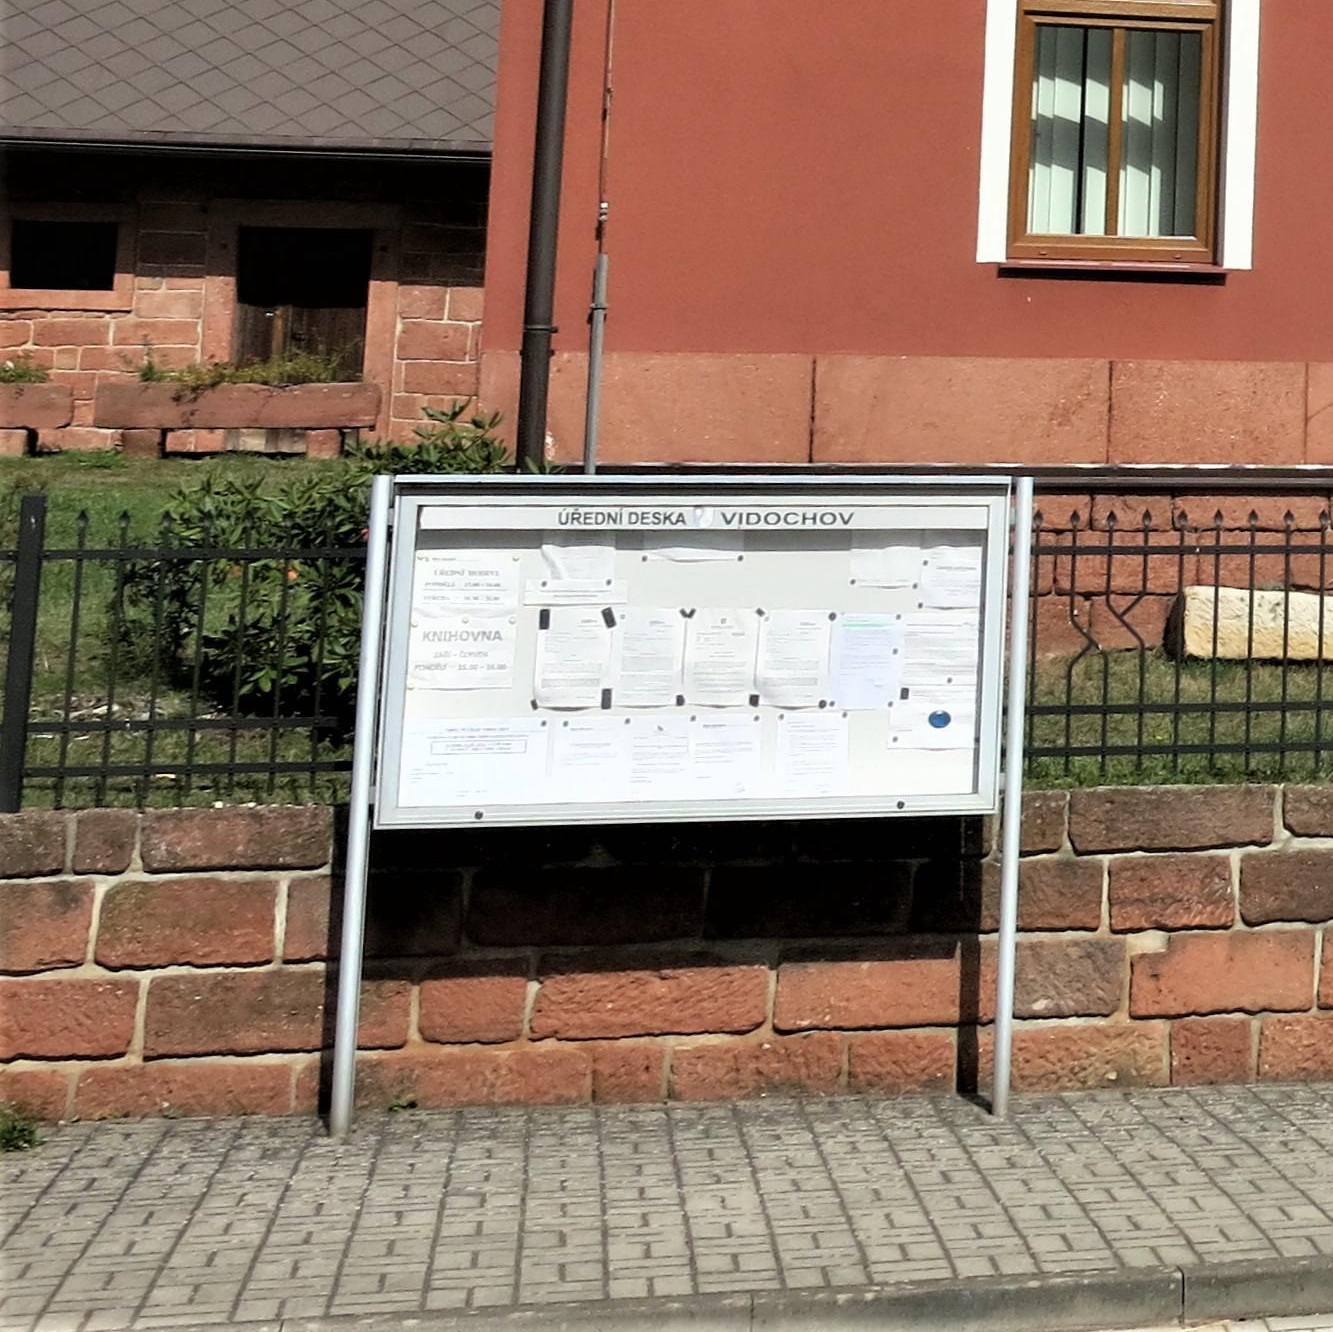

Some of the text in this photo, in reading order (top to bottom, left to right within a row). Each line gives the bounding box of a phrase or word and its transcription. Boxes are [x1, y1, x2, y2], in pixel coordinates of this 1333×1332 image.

[558, 508, 855, 526] ÚŘEDNÍ DESKA VIDOCHOV
[422, 630, 503, 642] KNIHOVNA
